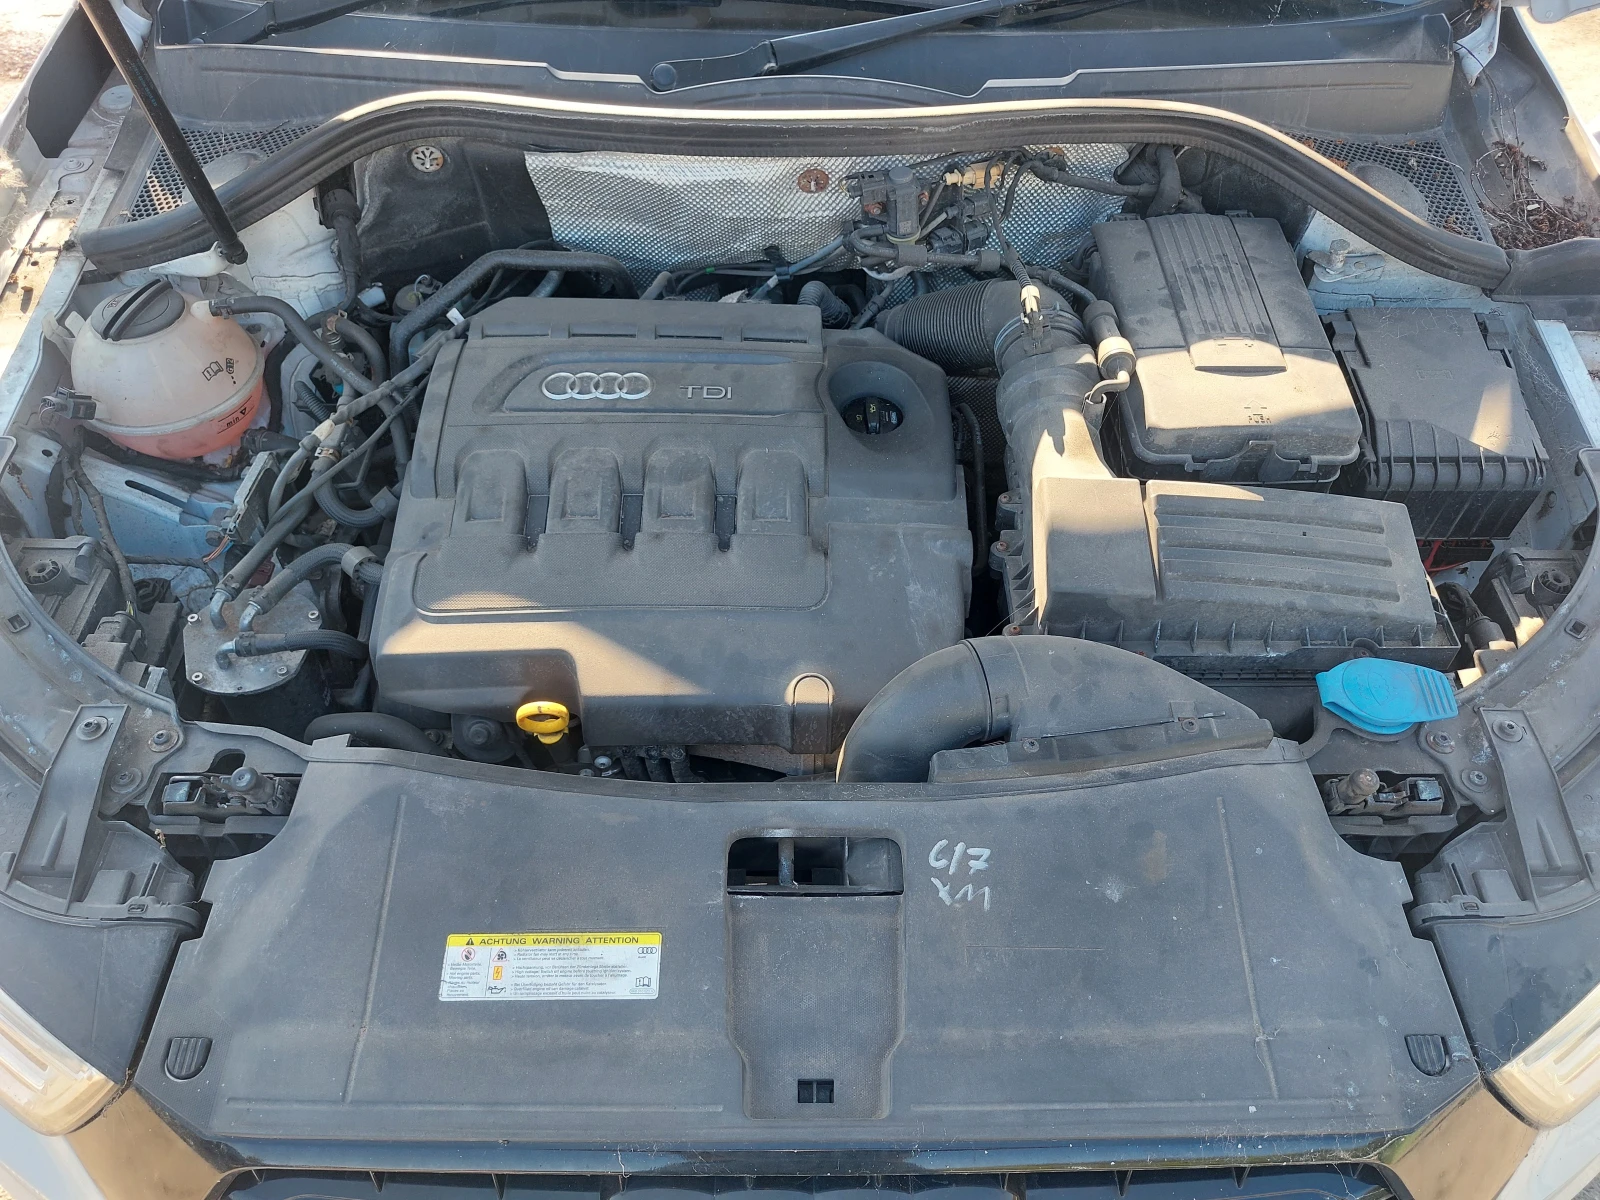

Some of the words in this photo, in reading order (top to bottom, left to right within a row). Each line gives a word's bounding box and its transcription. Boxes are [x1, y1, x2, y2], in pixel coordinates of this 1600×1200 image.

[679, 385, 733, 400] TDI
[226, 416, 240, 428] min
[585, 936, 639, 944] ATTENTION
